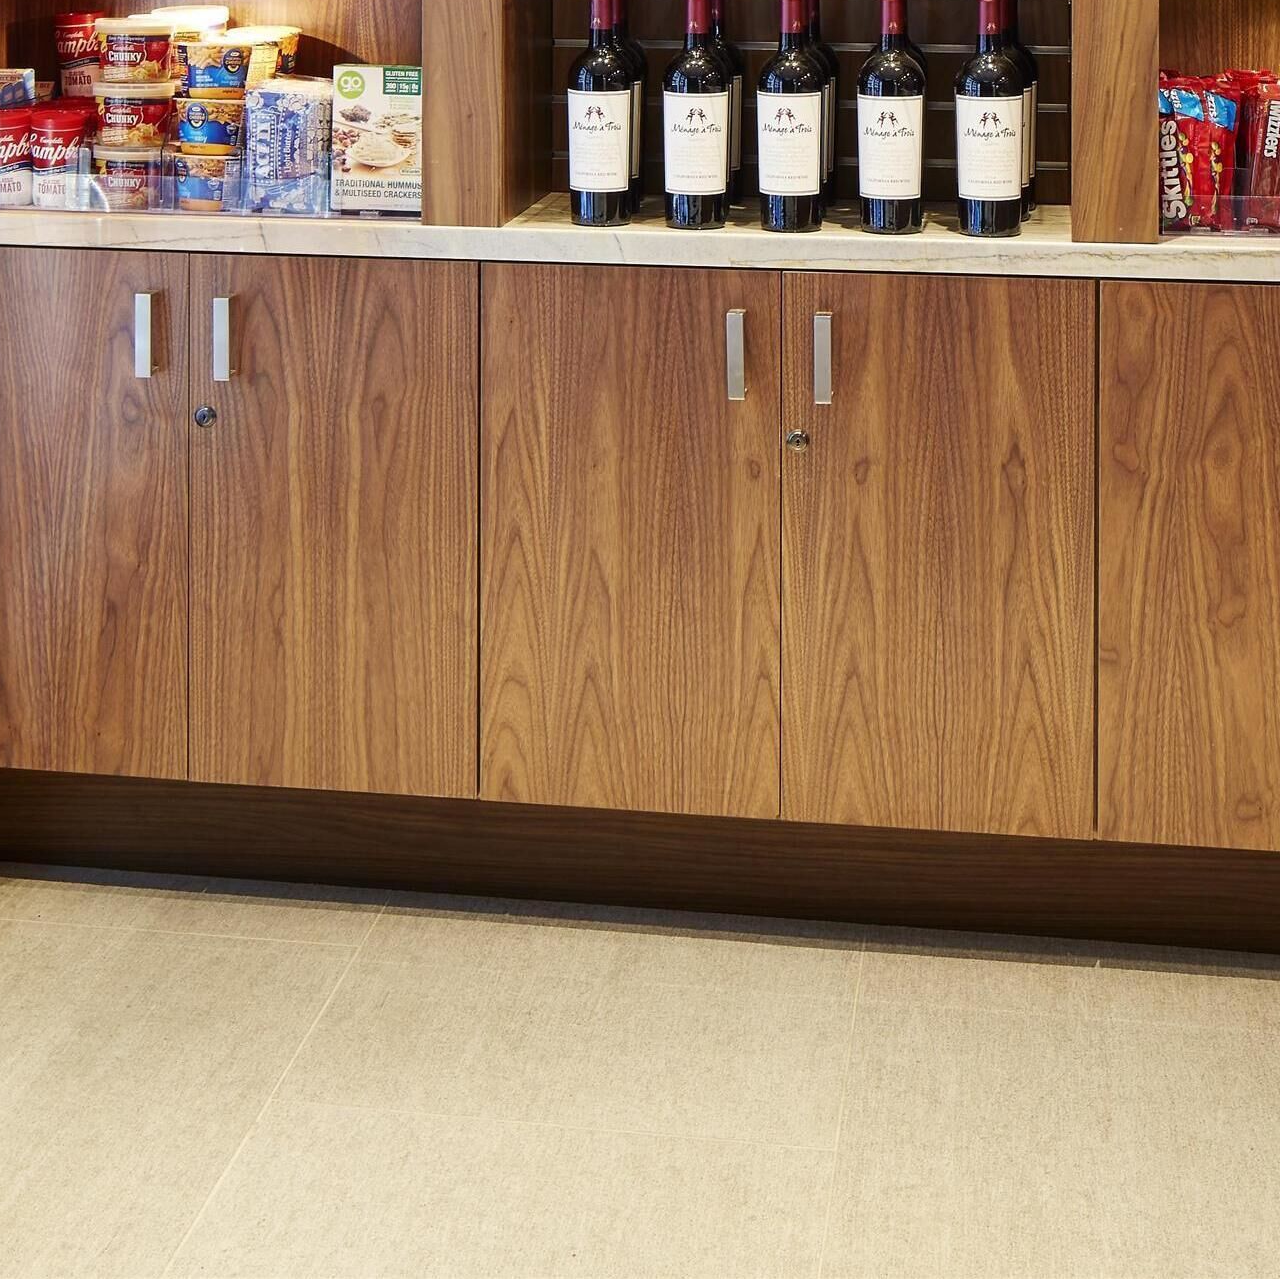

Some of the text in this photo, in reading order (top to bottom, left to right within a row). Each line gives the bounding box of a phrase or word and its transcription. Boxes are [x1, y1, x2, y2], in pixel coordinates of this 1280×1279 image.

[108, 50, 142, 62] CHUNKY
[340, 76, 361, 92] go
[106, 114, 139, 125] CHUNKY
[1161, 120, 1187, 219] Skittles
[336, 179, 422, 190] TRADITIONAL HUMMUS
[335, 189, 422, 199] & MULTISEED CRACKERS
